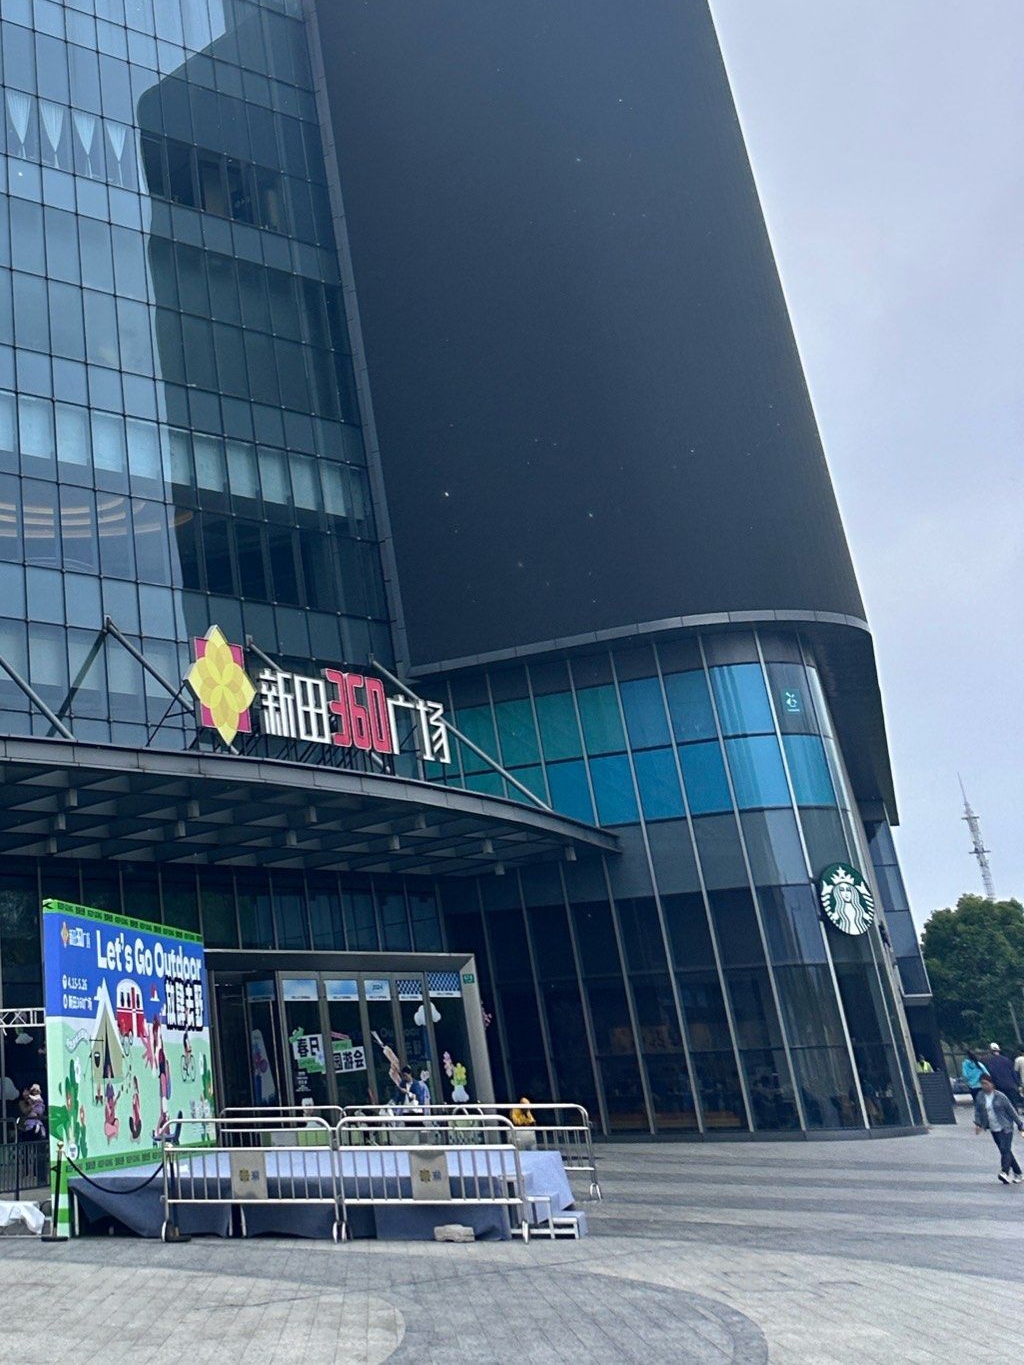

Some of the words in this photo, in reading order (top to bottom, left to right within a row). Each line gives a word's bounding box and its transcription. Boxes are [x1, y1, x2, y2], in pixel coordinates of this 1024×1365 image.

[259, 668, 451, 764] 新田360广场
[96, 929, 134, 973] Let's
[134, 938, 153, 977] Go
[154, 942, 202, 981] Outdoor
